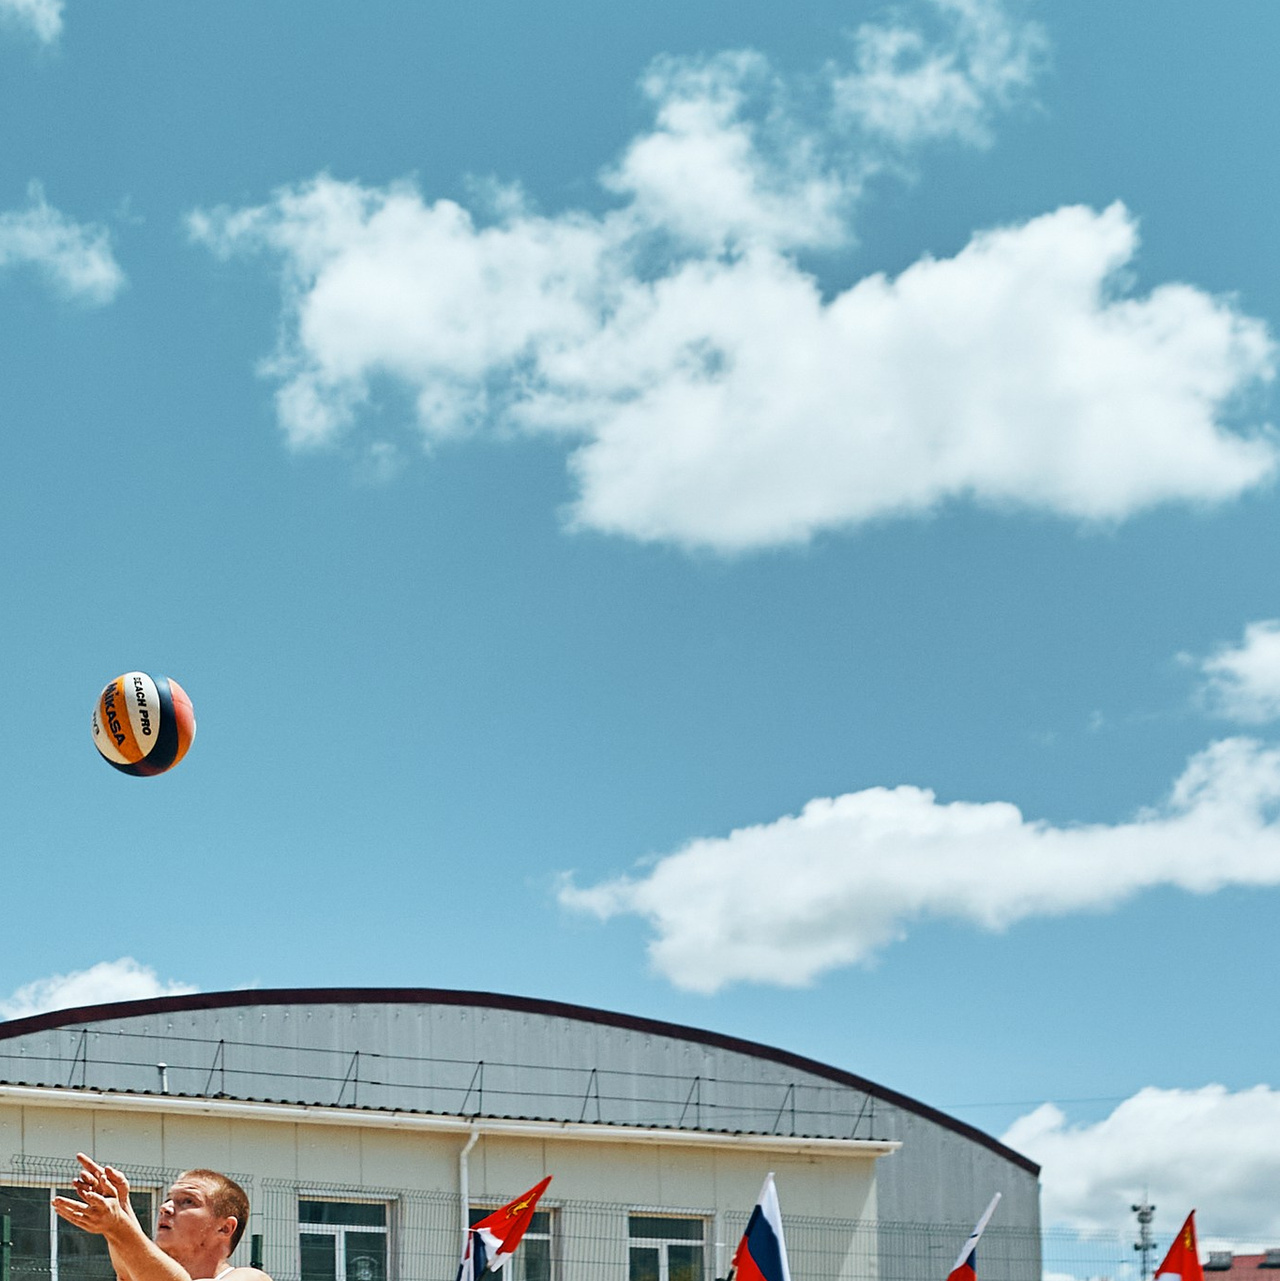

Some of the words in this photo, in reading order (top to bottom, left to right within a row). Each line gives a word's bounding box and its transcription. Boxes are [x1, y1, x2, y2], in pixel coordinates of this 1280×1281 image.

[133, 677, 148, 707] BEACH
[104, 682, 126, 746] MIKASA
[139, 709, 152, 736] PRO
